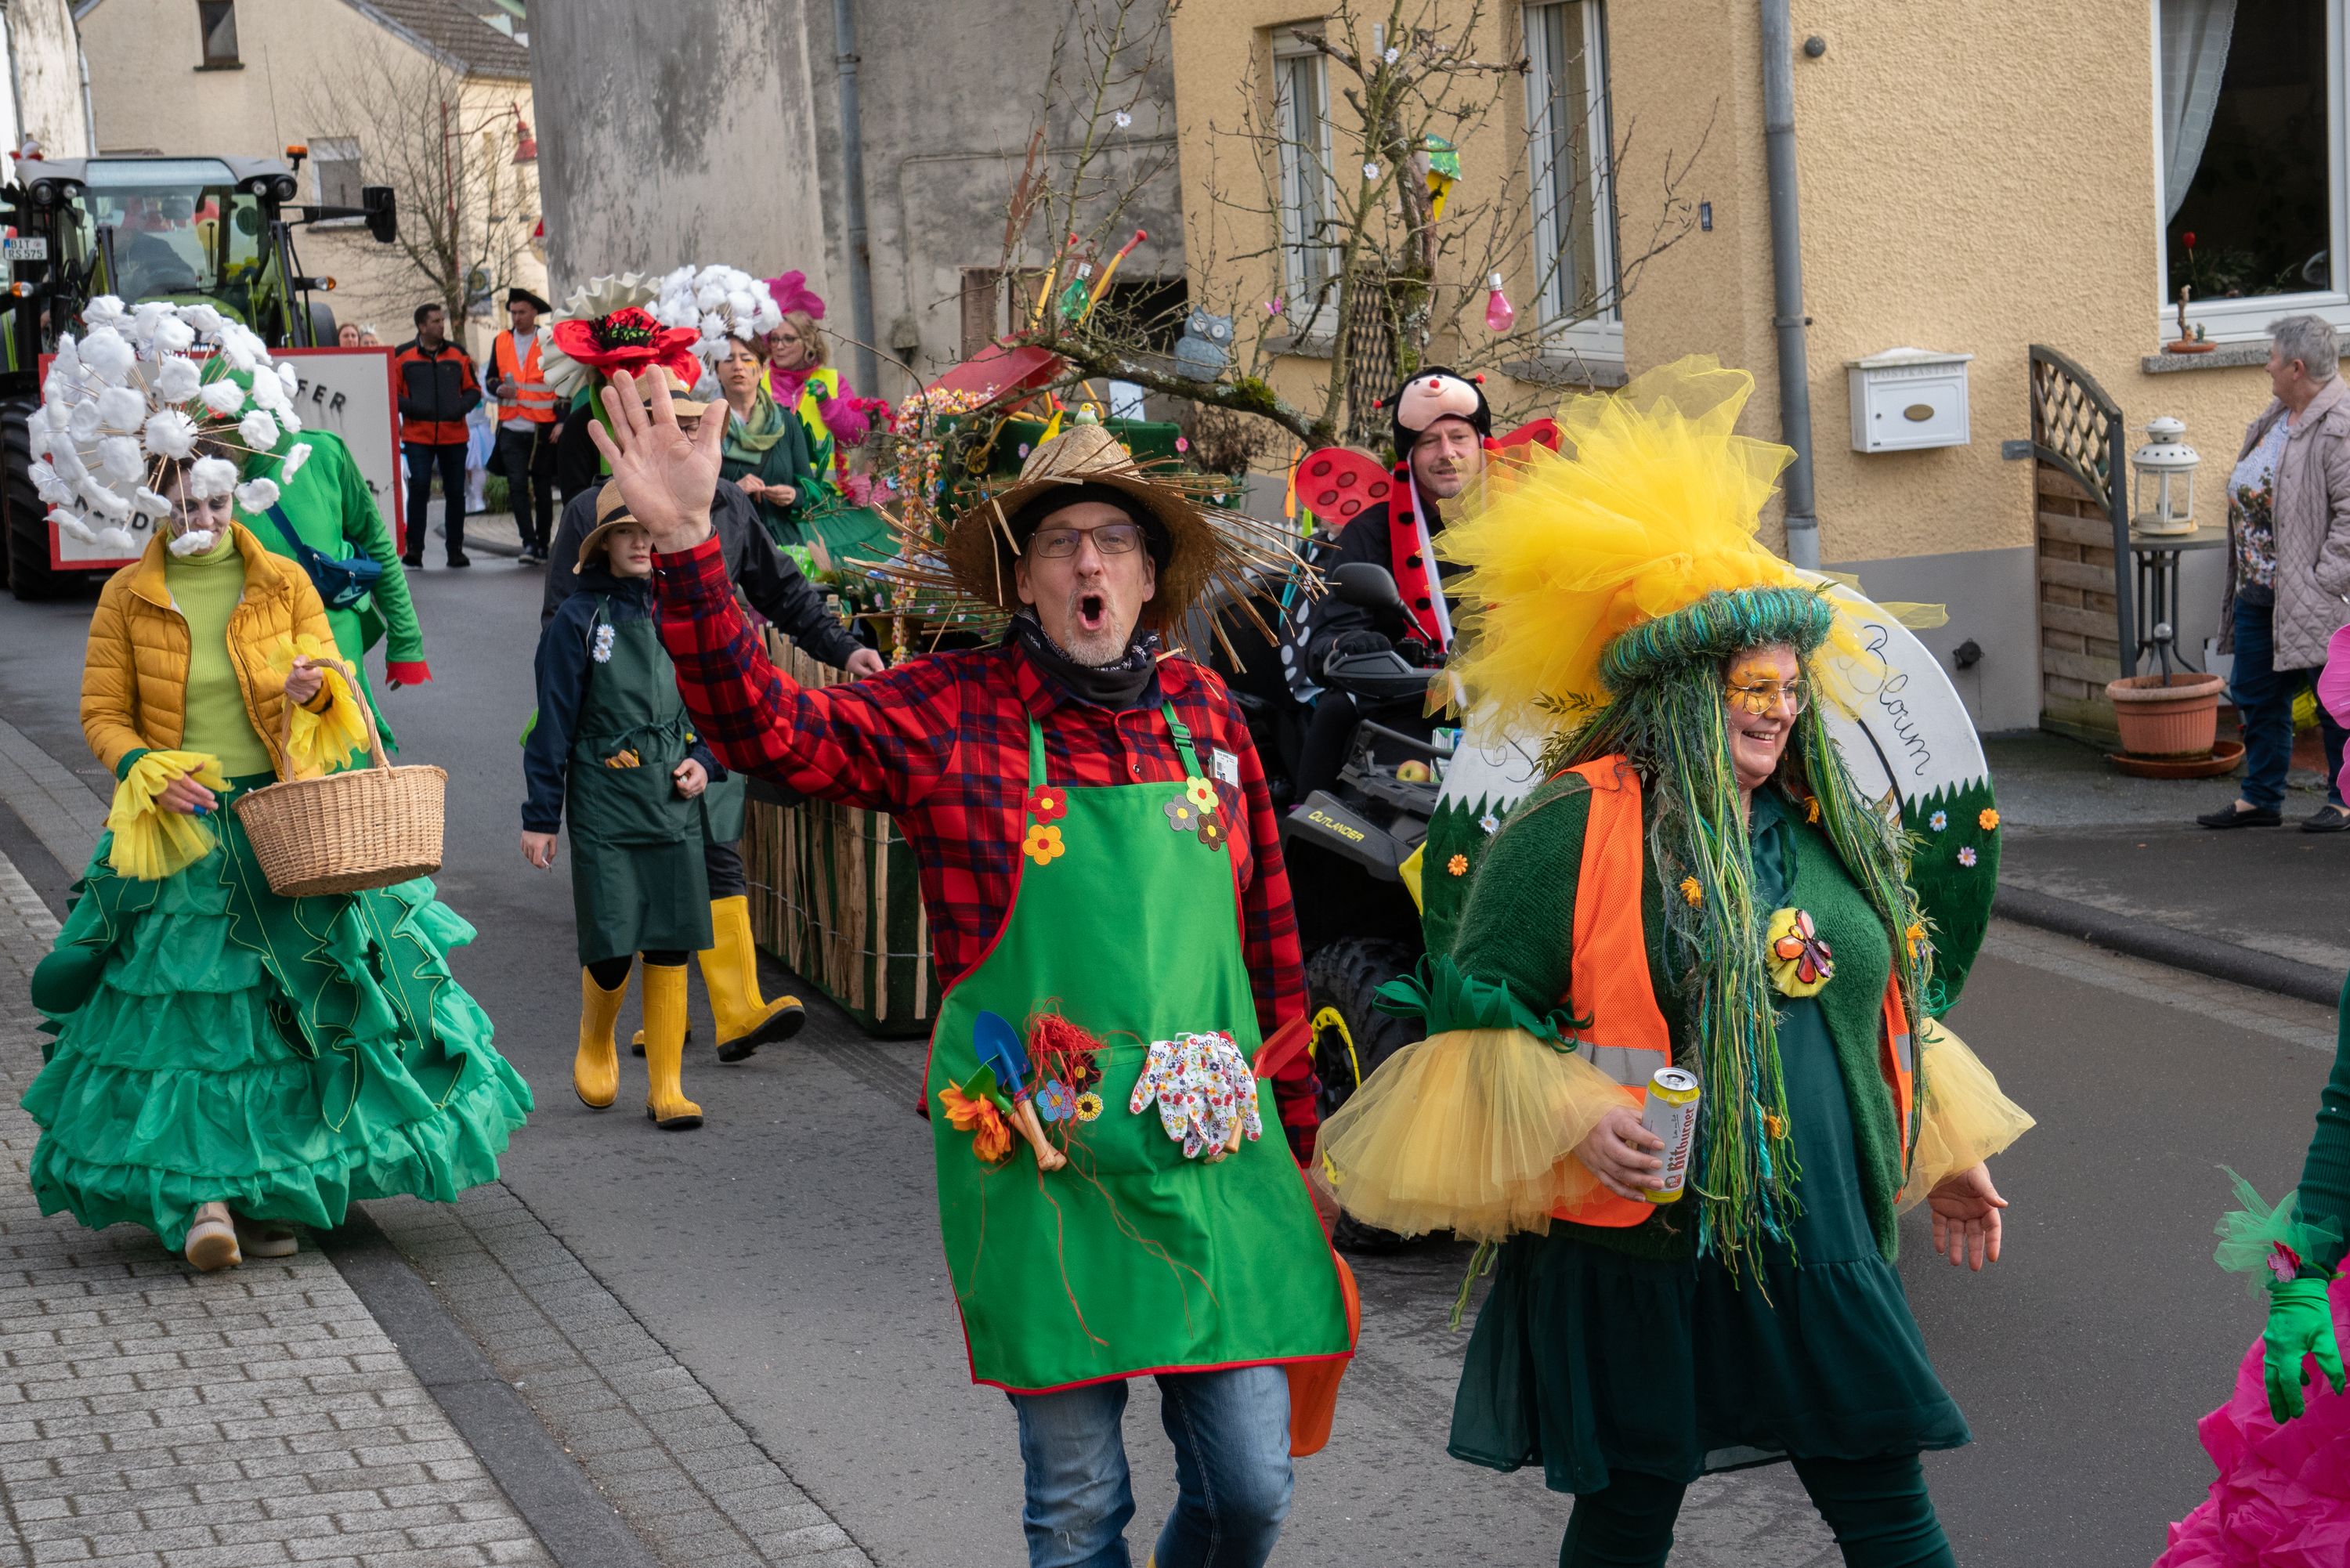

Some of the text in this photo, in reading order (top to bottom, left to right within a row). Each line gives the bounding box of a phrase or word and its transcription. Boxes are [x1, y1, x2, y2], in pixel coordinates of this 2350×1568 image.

[9, 249, 42, 258] RS 575
[11, 240, 30, 248] BIT
[1873, 364, 1958, 378] POSTKASTEN
[296, 378, 346, 413] FER
[1308, 811, 1365, 842] OUTLANDER
[1667, 1107, 1695, 1172] Bitburger
